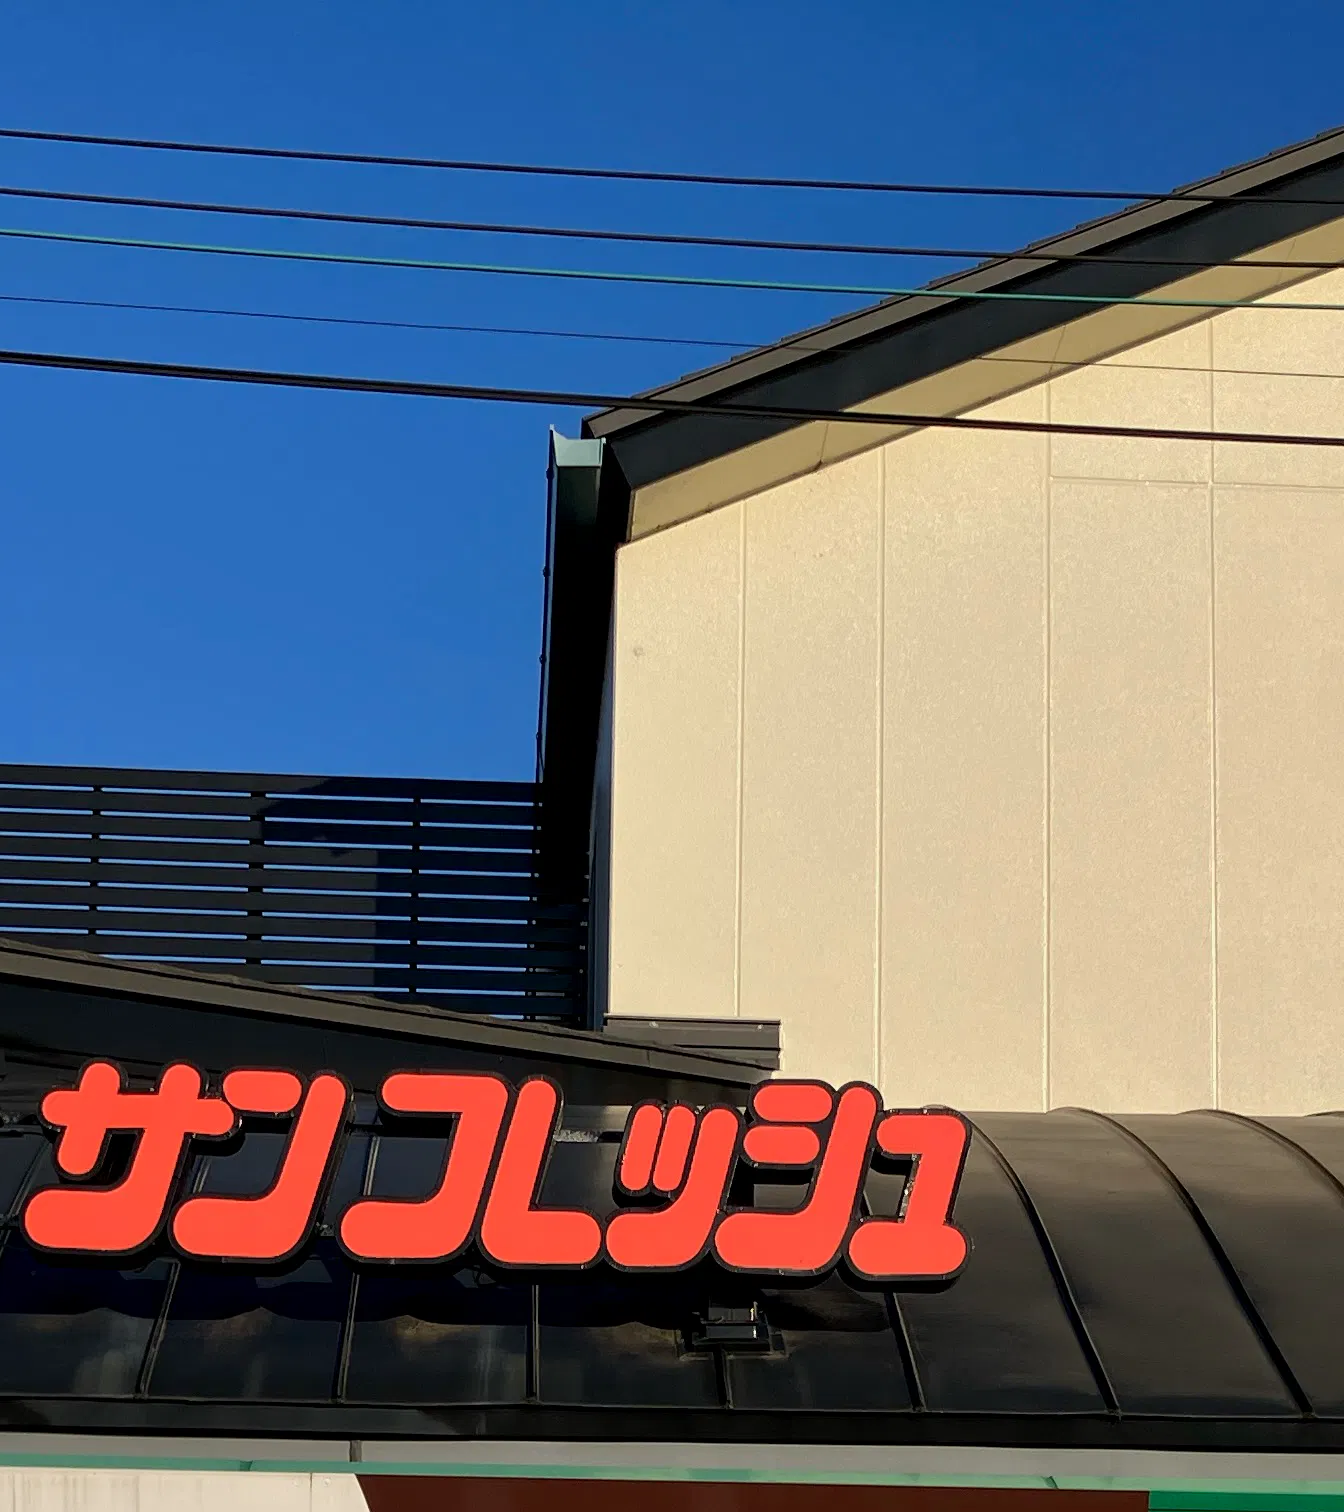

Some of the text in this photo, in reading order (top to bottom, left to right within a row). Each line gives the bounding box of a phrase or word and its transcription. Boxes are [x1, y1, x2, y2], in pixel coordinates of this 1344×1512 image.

[22, 1059, 970, 1280] サンフレッシュ
